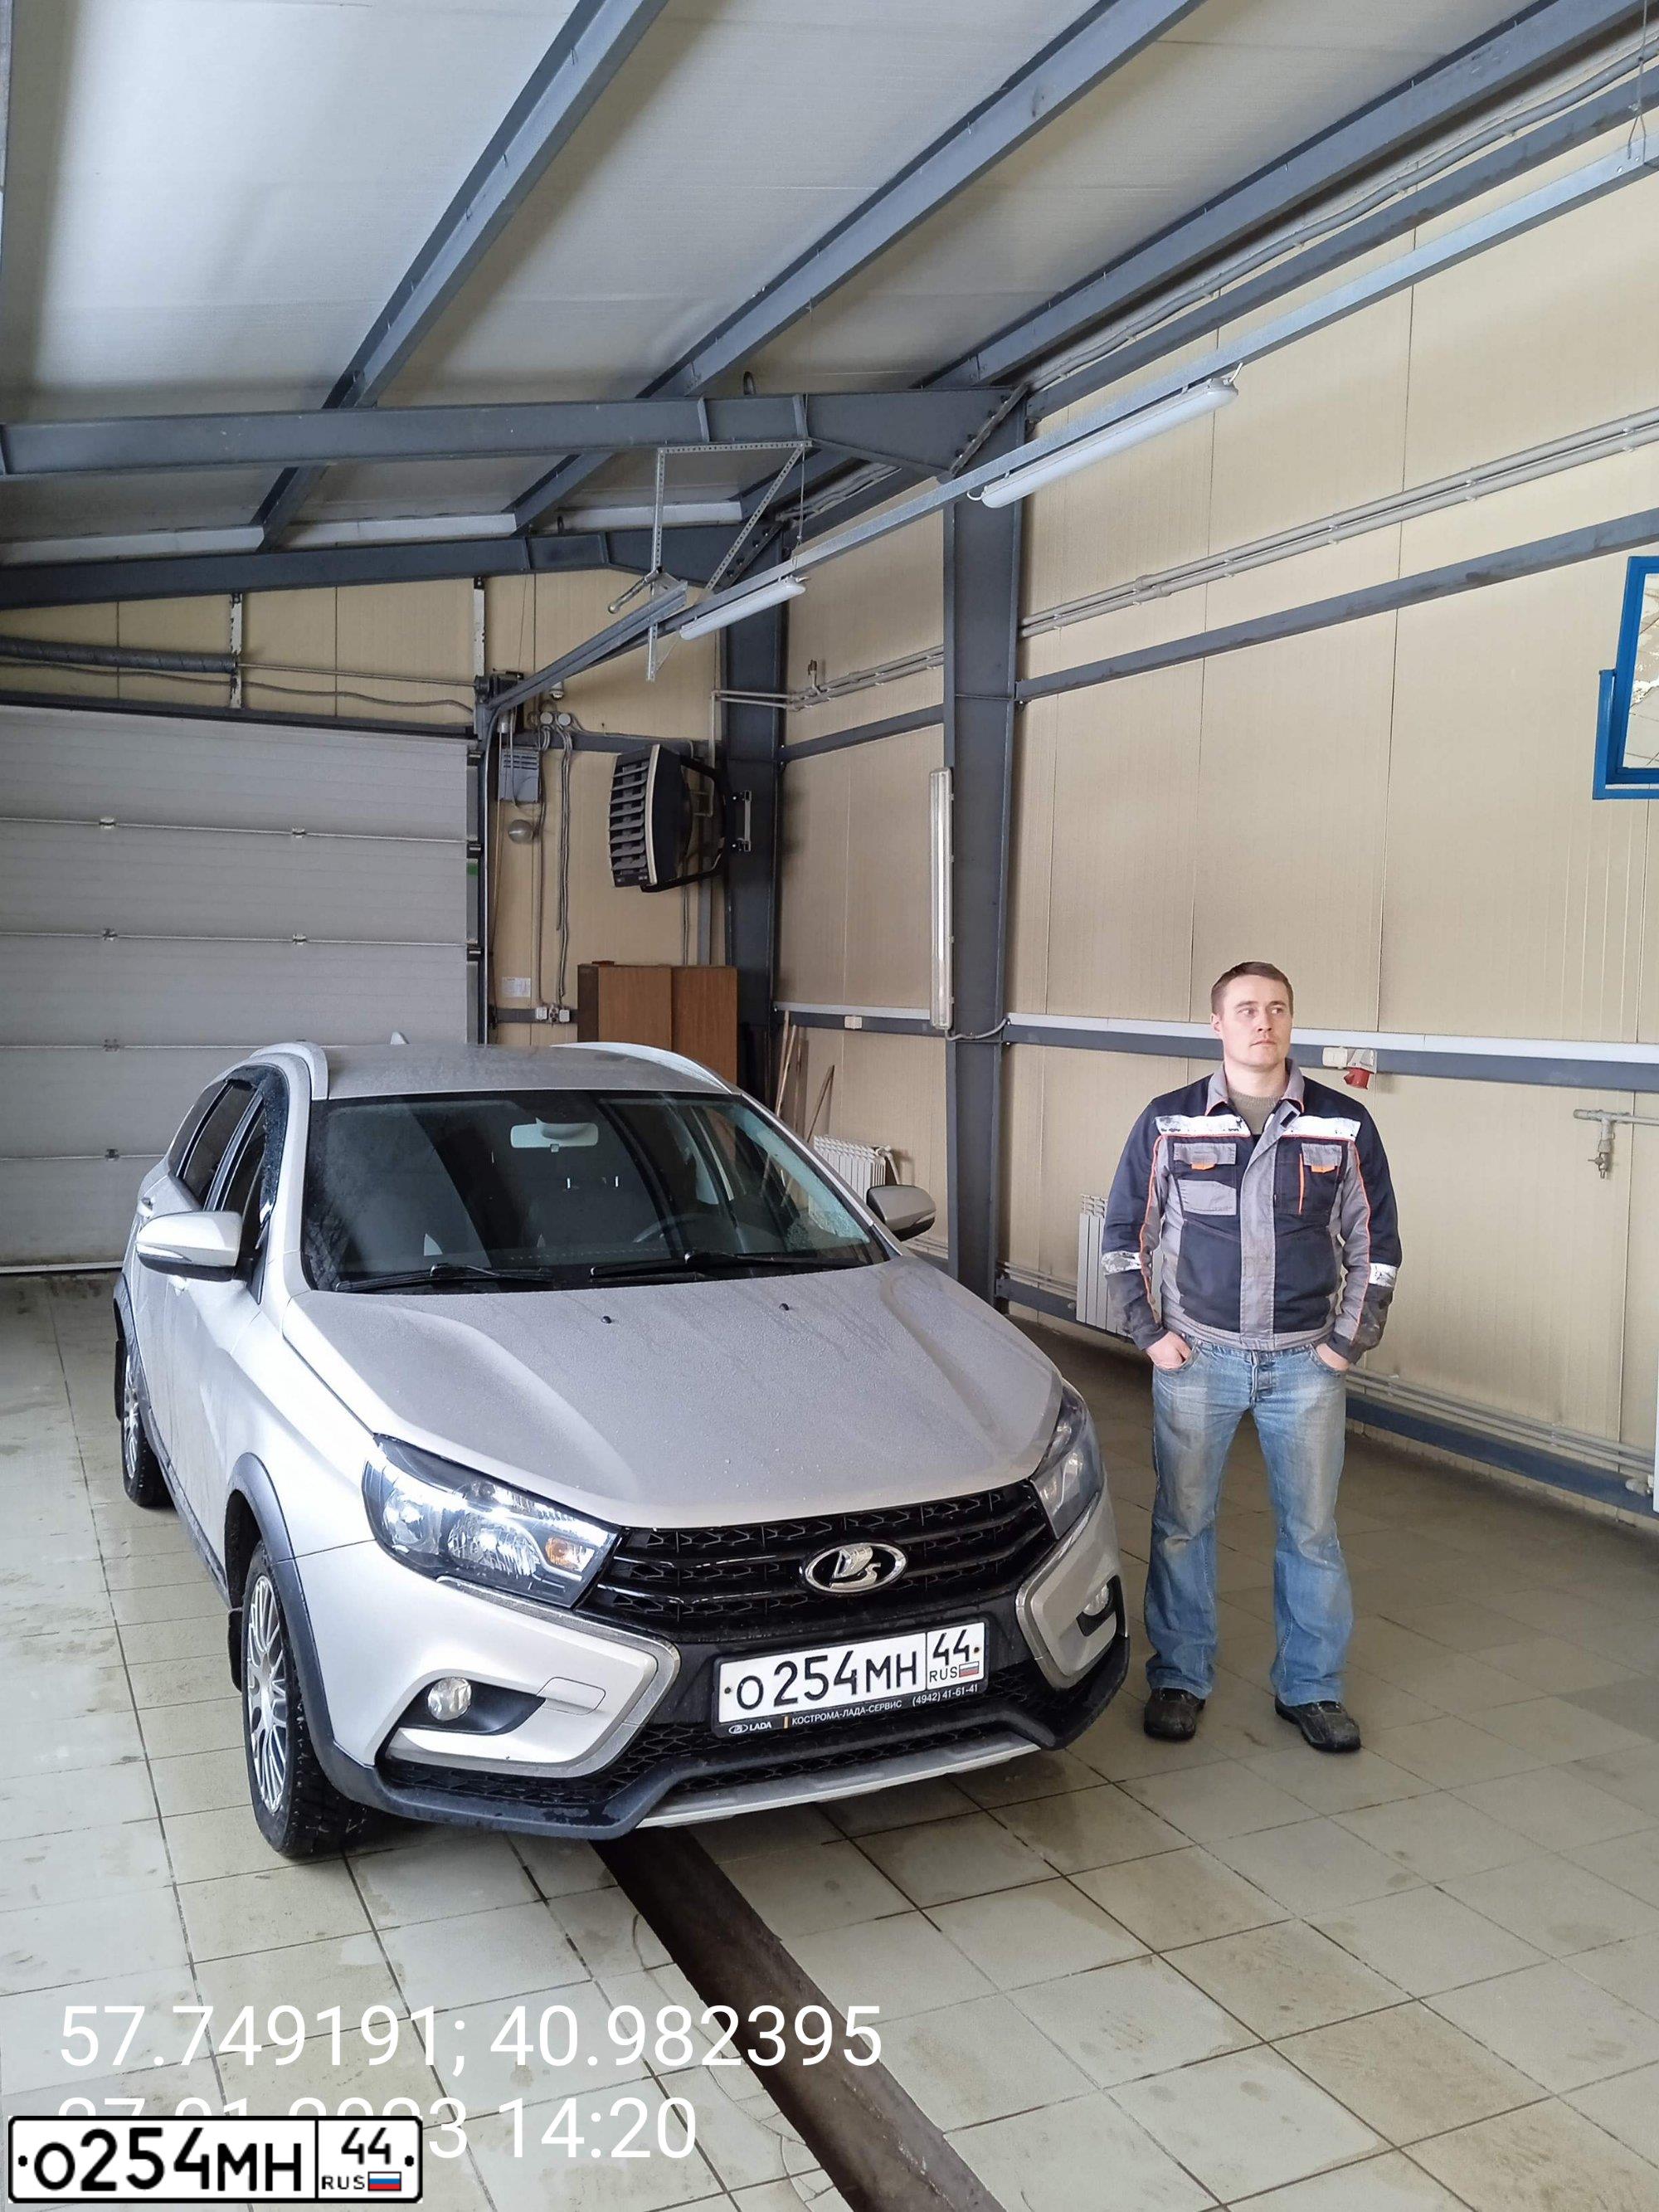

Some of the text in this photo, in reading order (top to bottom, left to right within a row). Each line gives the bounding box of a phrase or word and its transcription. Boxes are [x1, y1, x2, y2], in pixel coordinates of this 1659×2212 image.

[932, 1630, 971, 1666] 44
[929, 1667, 958, 1683] RUS
[791, 1684, 978, 1726] КОСТРОМА-ЛАДА-СЕРВИС (4942) 41-61-41
[749, 1721, 772, 1731] LADA
